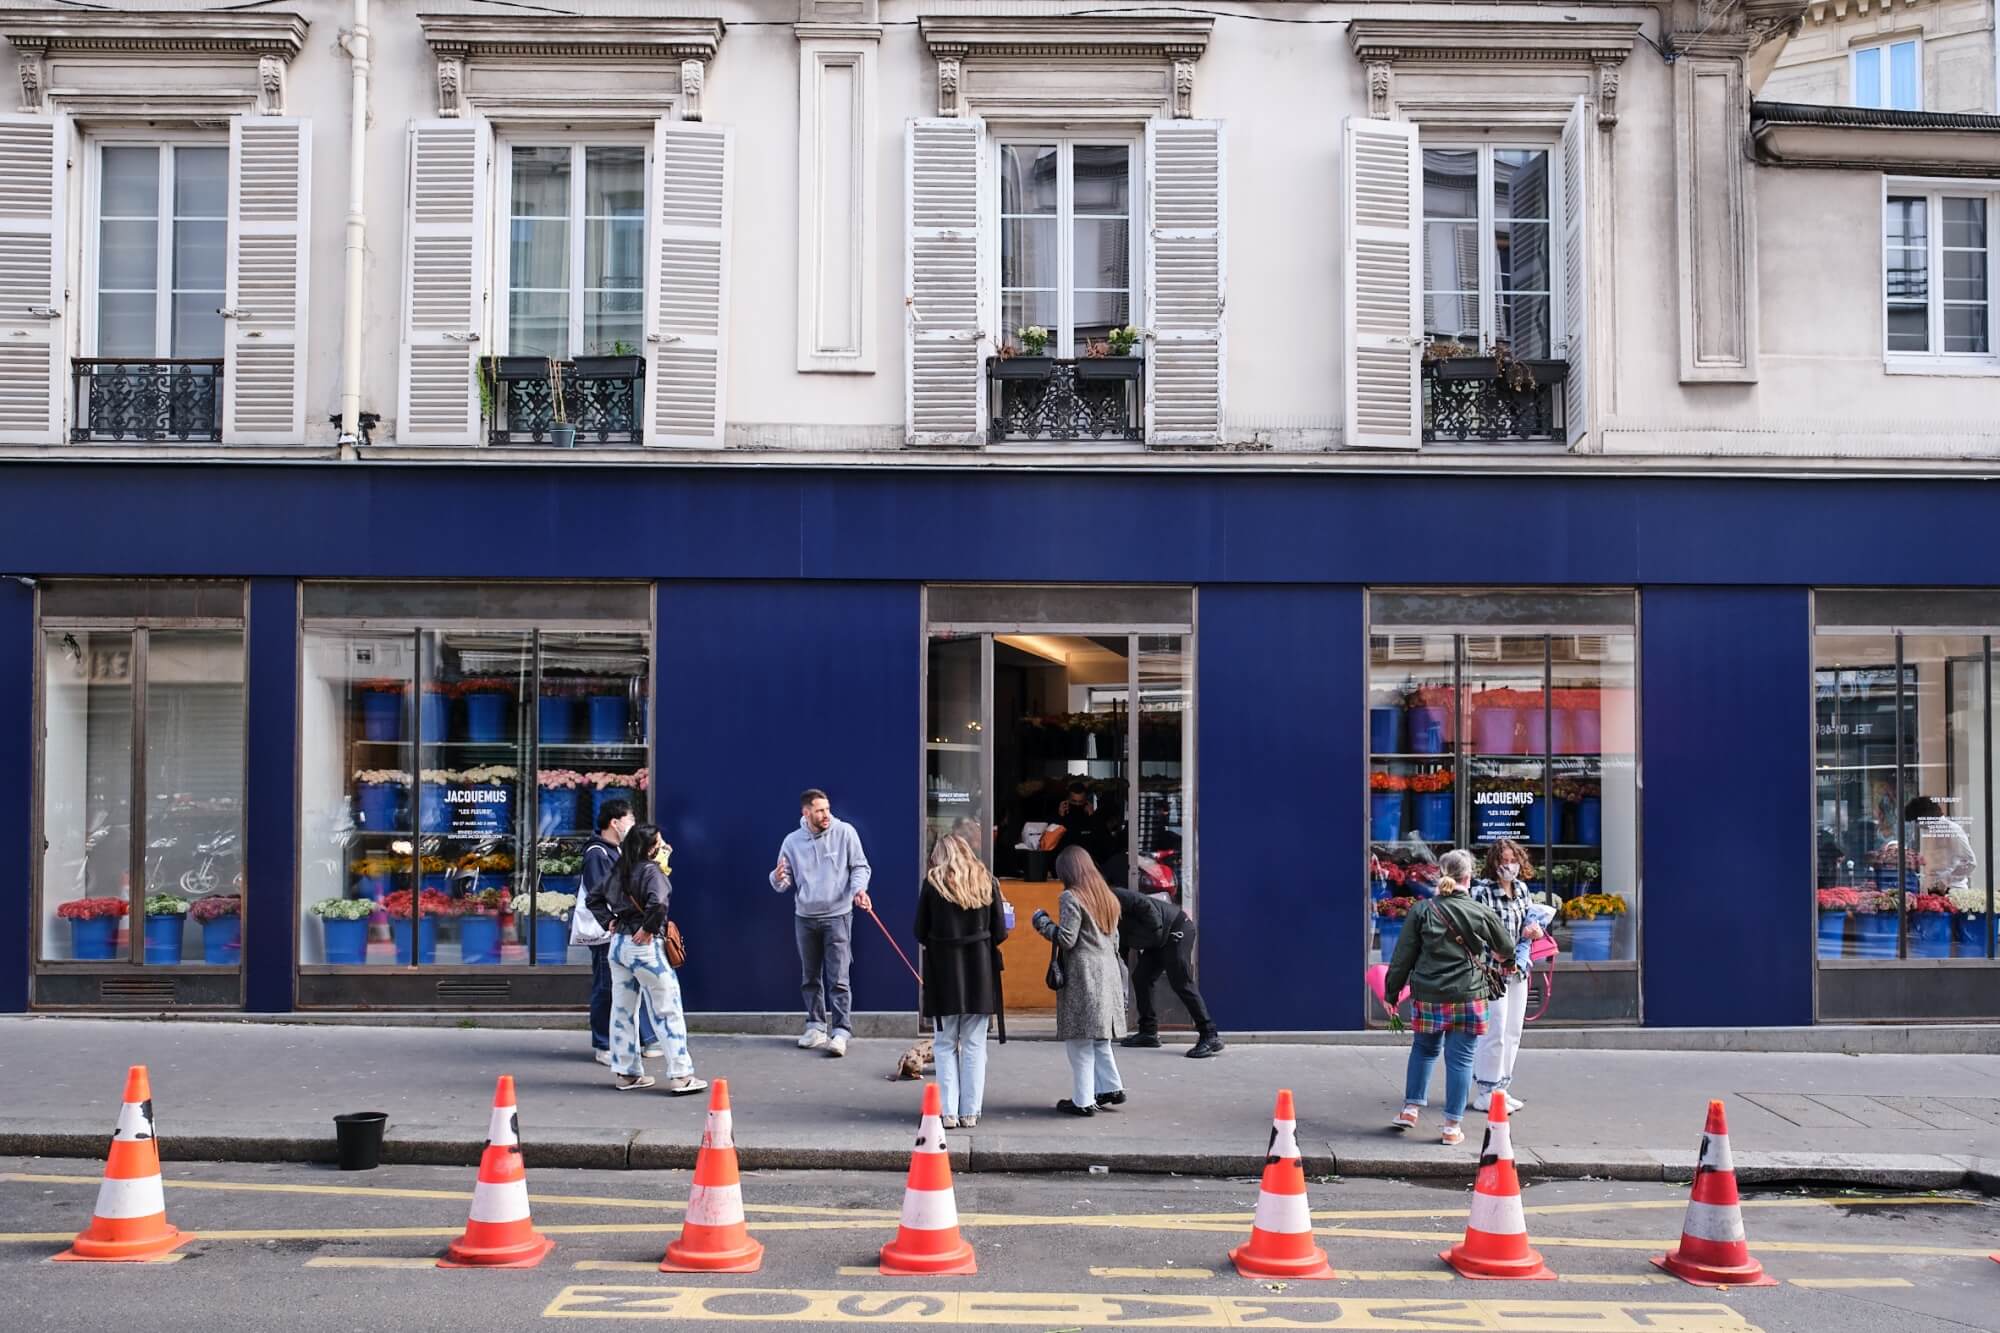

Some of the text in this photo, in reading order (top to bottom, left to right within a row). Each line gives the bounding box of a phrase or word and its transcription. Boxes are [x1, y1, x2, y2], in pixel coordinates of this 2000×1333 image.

[444, 790, 507, 803] JACQUEMUS
[1474, 791, 1534, 805] JACQUEMUS
[556, 1285, 1731, 1328] LIVRAISON
